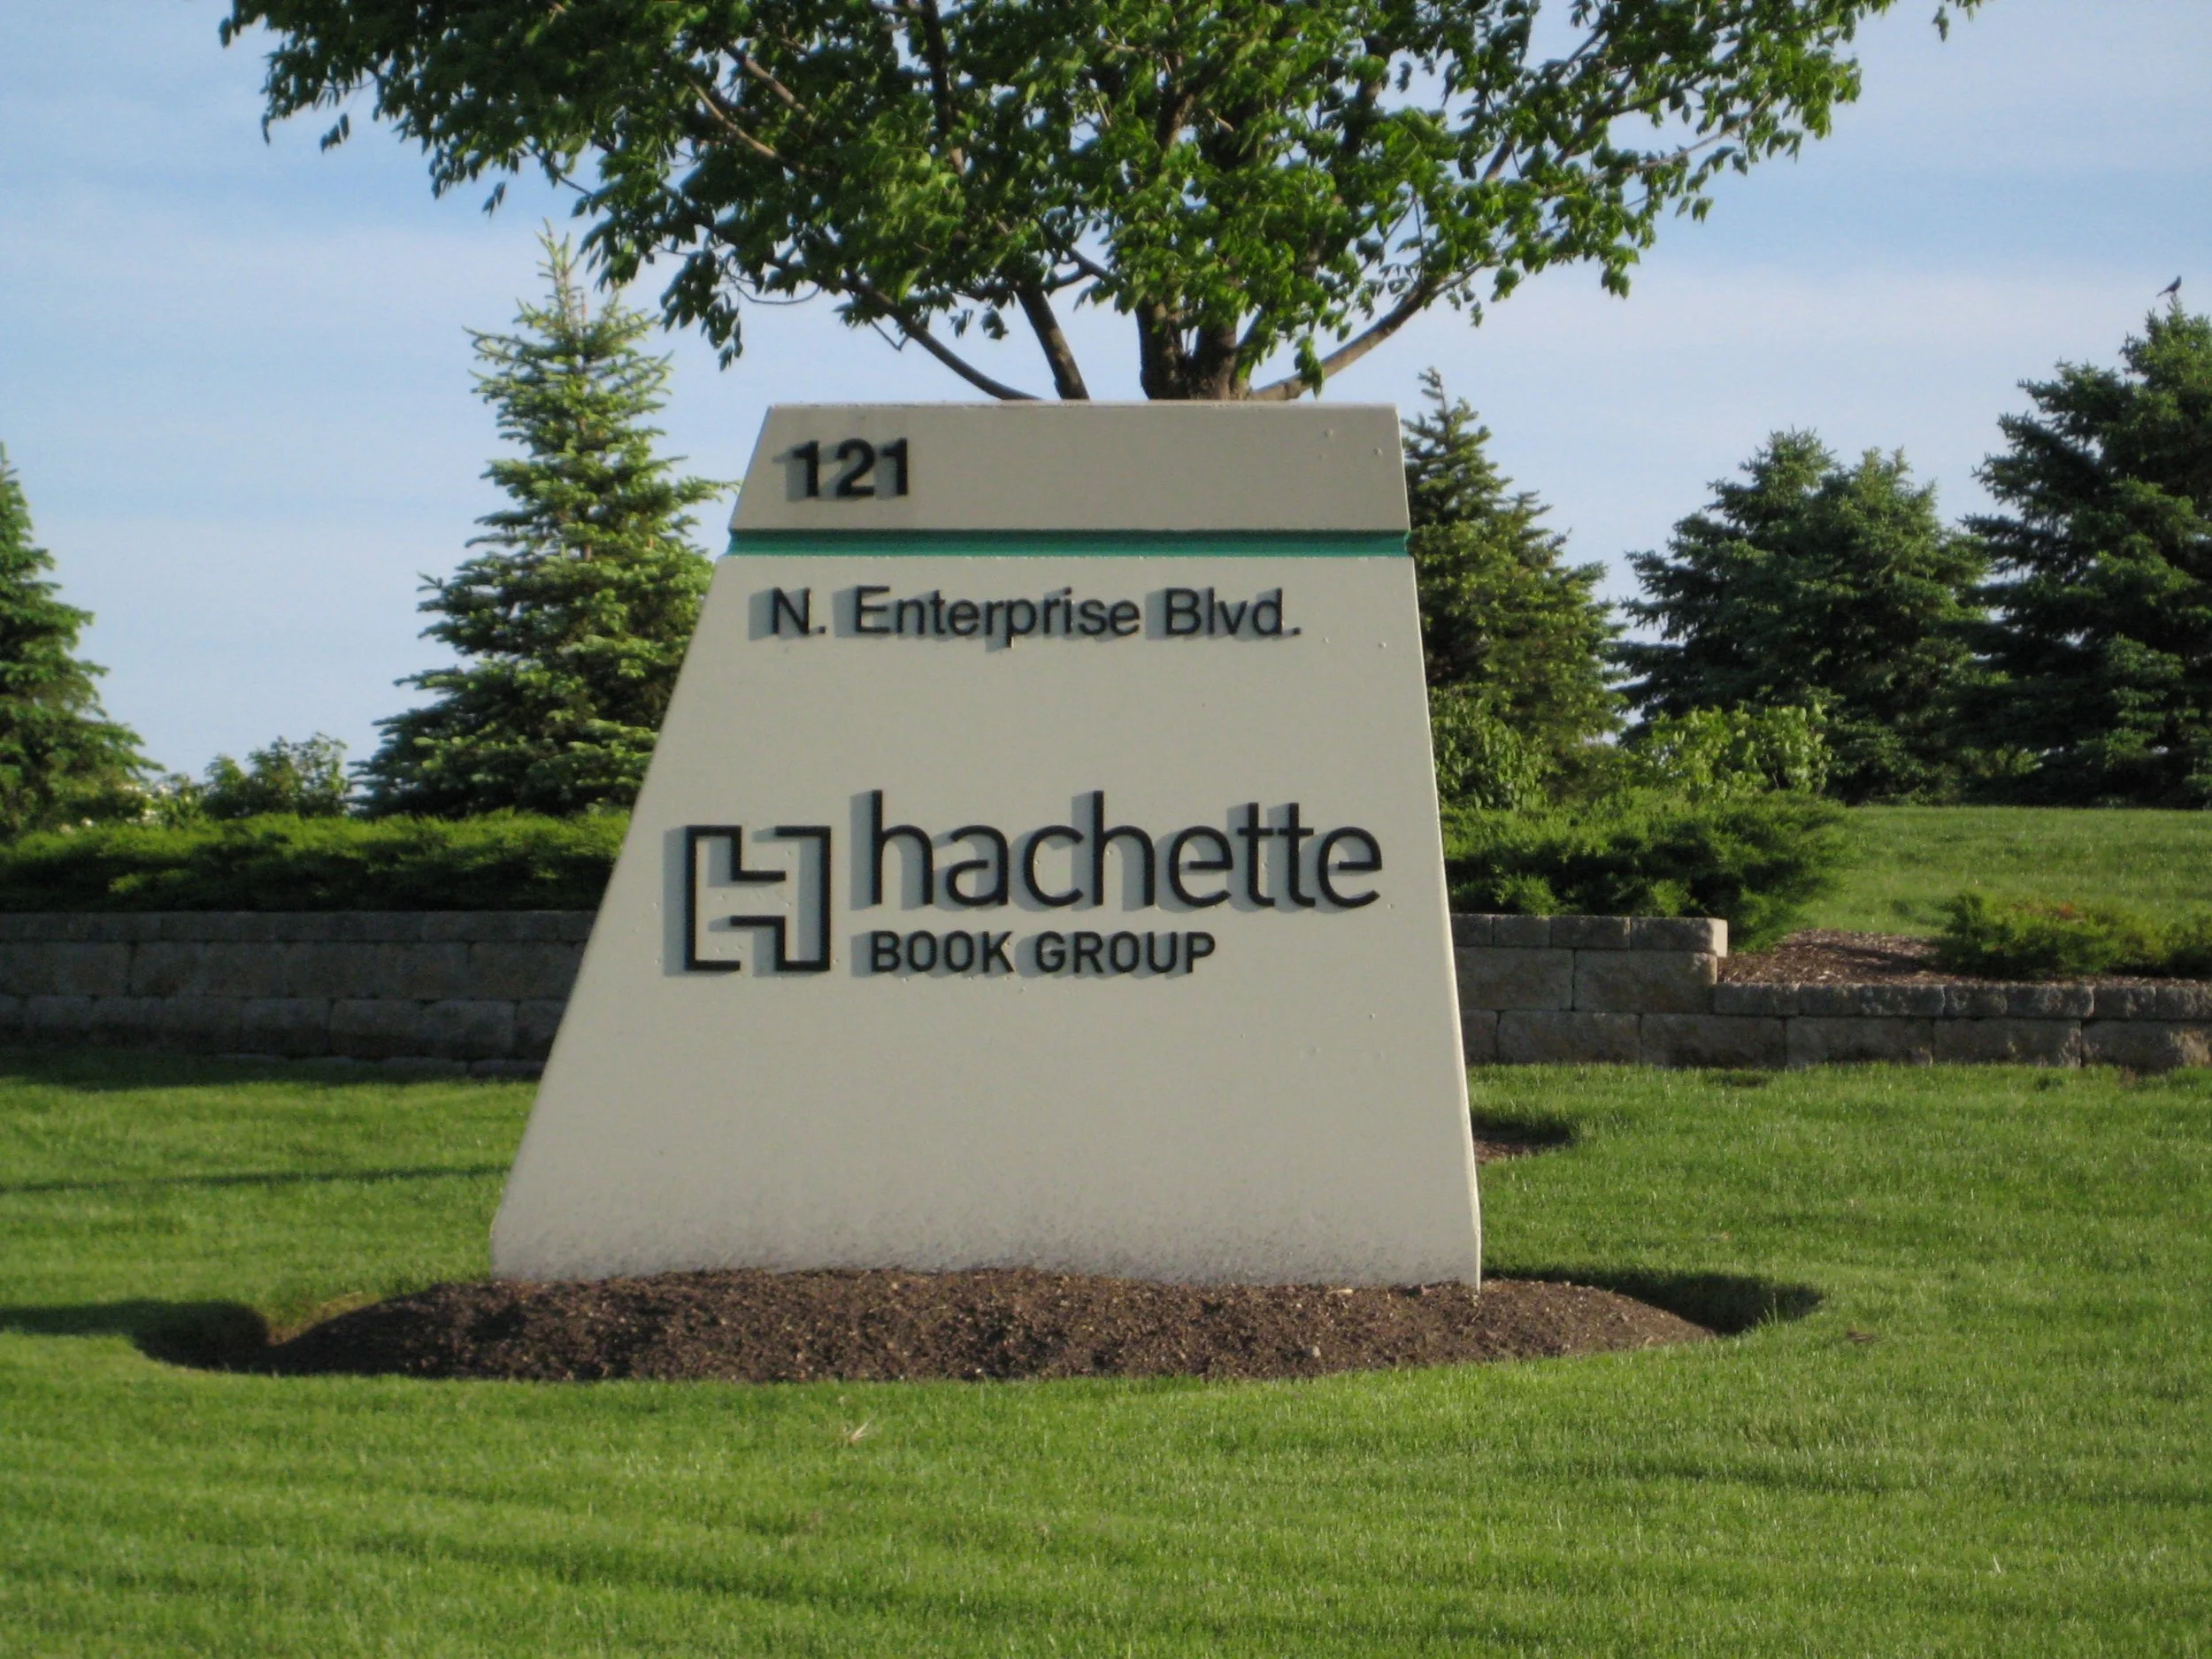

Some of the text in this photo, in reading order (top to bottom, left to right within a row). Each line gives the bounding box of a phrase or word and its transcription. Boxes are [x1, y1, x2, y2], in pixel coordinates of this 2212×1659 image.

[791, 437, 910, 498] 121
[769, 585, 1303, 649] N. Enterprise Blvd.
[868, 789, 1383, 910] hachette
[868, 930, 1217, 974] BOOK GROUP
